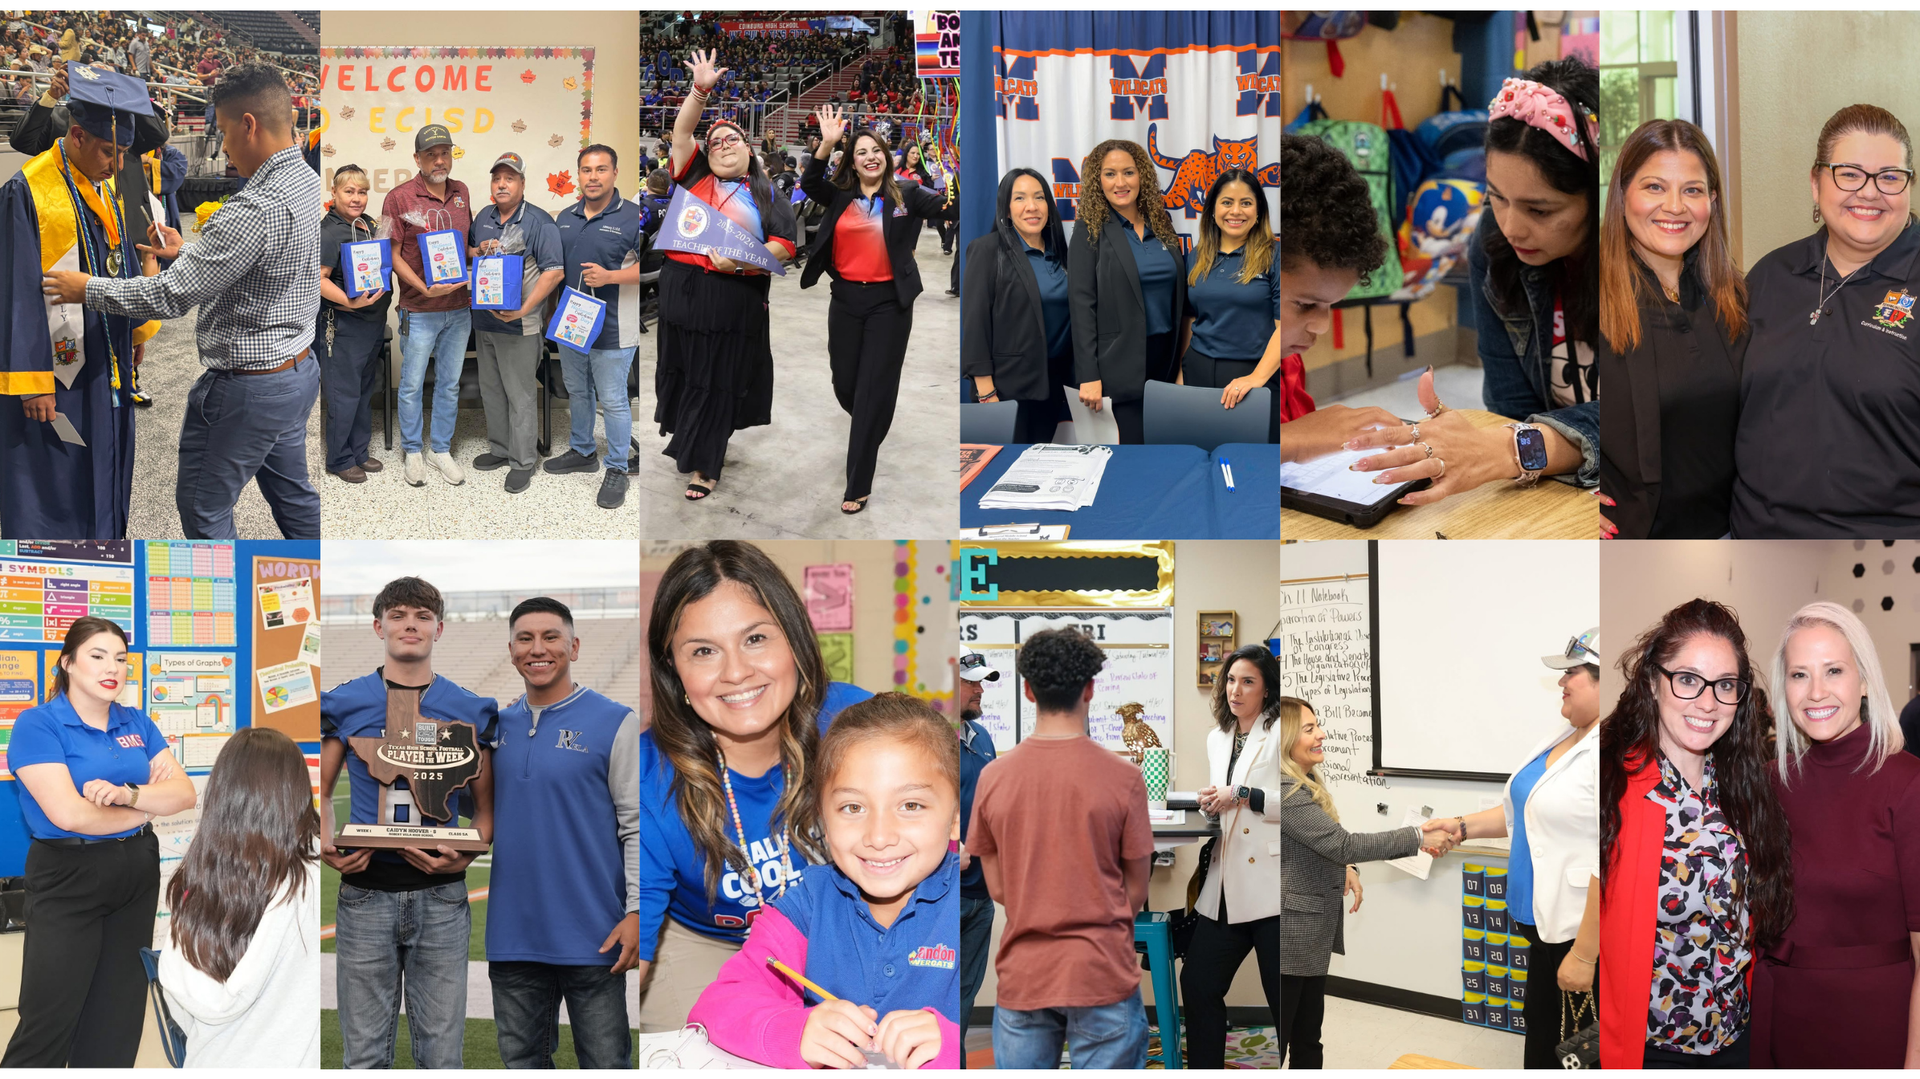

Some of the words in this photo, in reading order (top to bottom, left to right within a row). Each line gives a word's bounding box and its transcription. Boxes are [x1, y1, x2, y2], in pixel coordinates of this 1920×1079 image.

[1110, 78, 1168, 96] WILDCATS
[369, 106, 495, 134] ECISD
[716, 218, 756, 249] 2025-2026
[672, 239, 712, 252] TEACHER
[723, 246, 742, 258] THE
[744, 250, 768, 267] YEAR
[9, 564, 74, 577] SYMBOLS
[258, 562, 311, 579] WORD
[960, 548, 998, 601] E
[1311, 587, 1349, 604] Notebook
[1329, 607, 1362, 623] Powers
[164, 659, 186, 667] Types
[196, 659, 222, 667] Graphs
[1303, 653, 1323, 665] House
[1324, 652, 1339, 663] and
[1292, 671, 1308, 686] The
[1310, 669, 1351, 689] Legislative
[1324, 684, 1332, 695] of
[1322, 704, 1342, 719] Bill
[116, 734, 146, 748] BMS
[387, 750, 425, 764] PLAYER
[435, 751, 465, 764] WEEK
[413, 772, 443, 780] 2025
[1321, 768, 1391, 790] Representation
[1467, 880, 1478, 891] 07
[1490, 884, 1503, 894] 08
[1467, 913, 1479, 924] 13
[1490, 916, 1502, 928] 14
[1467, 946, 1480, 957] 19
[1491, 951, 1503, 962] 20
[1515, 954, 1527, 966] 21
[1466, 978, 1478, 989] 25
[1490, 982, 1502, 993] 26
[1513, 986, 1525, 997] 27
[1467, 1009, 1479, 1020] 31
[1490, 1012, 1502, 1024] 32
[1513, 1016, 1526, 1028] 33
